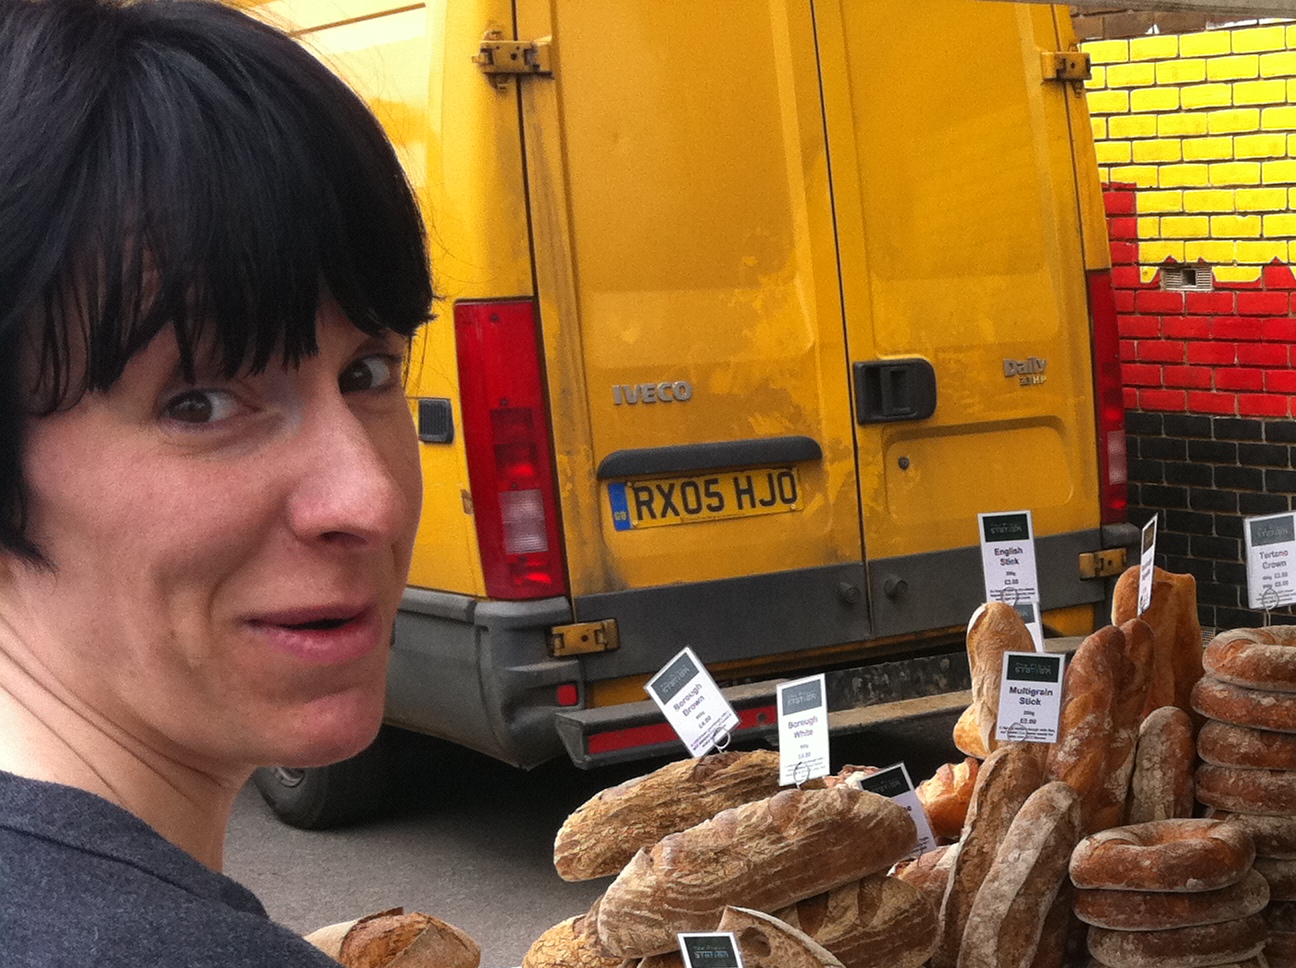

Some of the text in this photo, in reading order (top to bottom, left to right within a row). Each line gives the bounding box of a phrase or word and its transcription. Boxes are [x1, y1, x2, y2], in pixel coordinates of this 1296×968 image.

[1003, 356, 1047, 377] Daily
[612, 381, 692, 404] IVECO
[635, 478, 724, 520] RX05
[994, 547, 1023, 557] English
[1000, 558, 1020, 566] Stick
[1262, 560, 1287, 569] Crown
[673, 683, 702, 711] Borough
[1009, 686, 1053, 697] Multigrain
[682, 695, 705, 717] Brown
[1019, 697, 1041, 706] Stick
[787, 716, 818, 729] Borough
[794, 729, 813, 739] White
